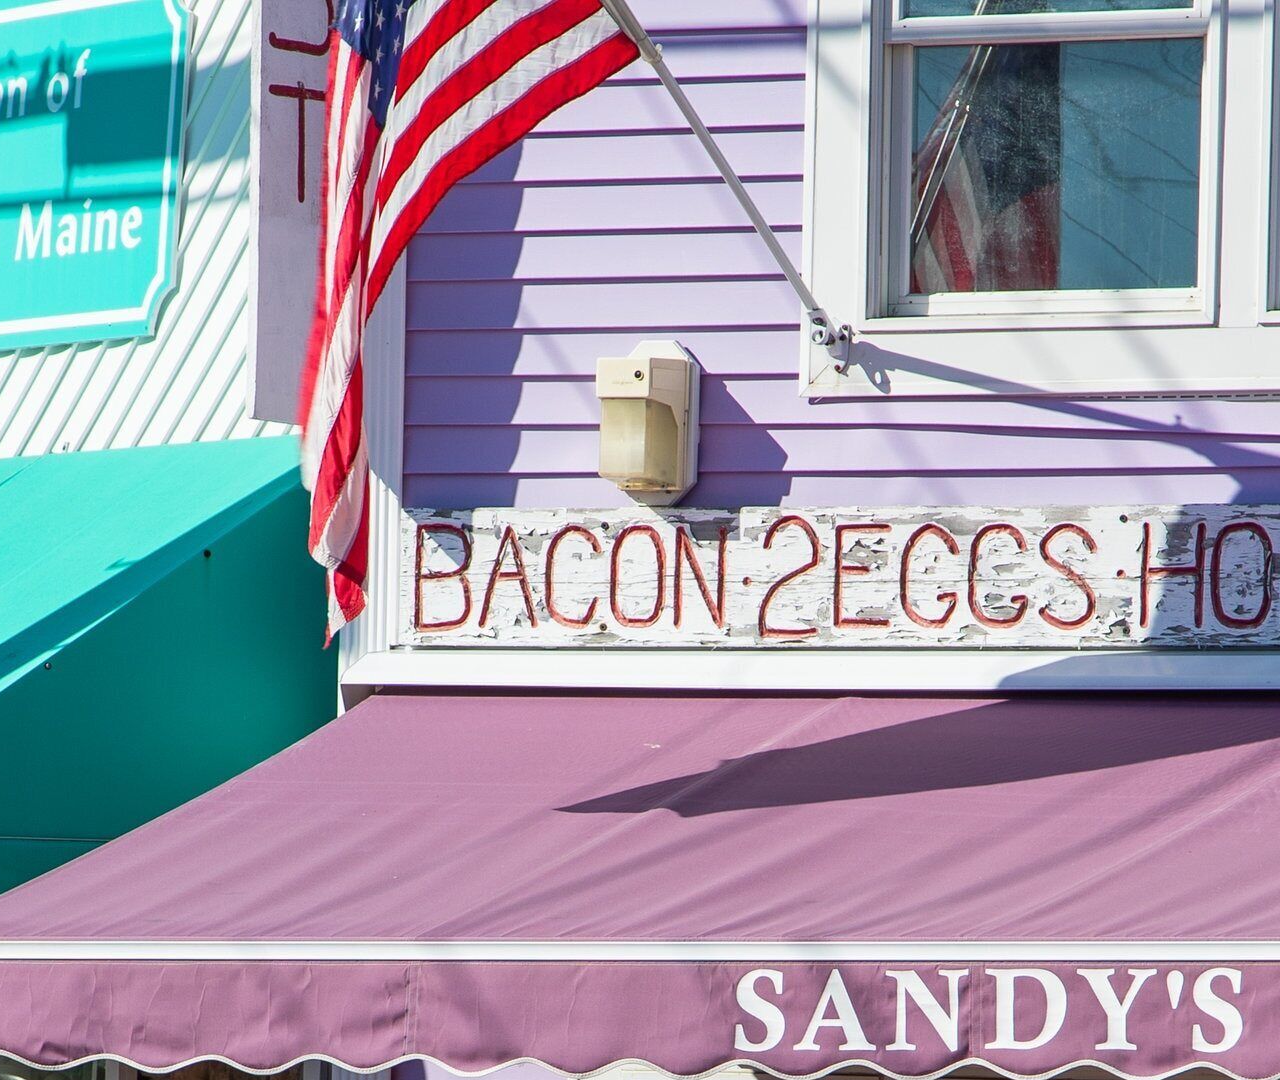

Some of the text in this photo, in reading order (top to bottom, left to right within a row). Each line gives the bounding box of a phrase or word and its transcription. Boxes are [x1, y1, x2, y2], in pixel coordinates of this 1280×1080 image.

[46, 48, 92, 114] of
[14, 200, 143, 261] Maine
[413, 522, 727, 633] BACON
[734, 967, 1244, 1054] SANDY'S
